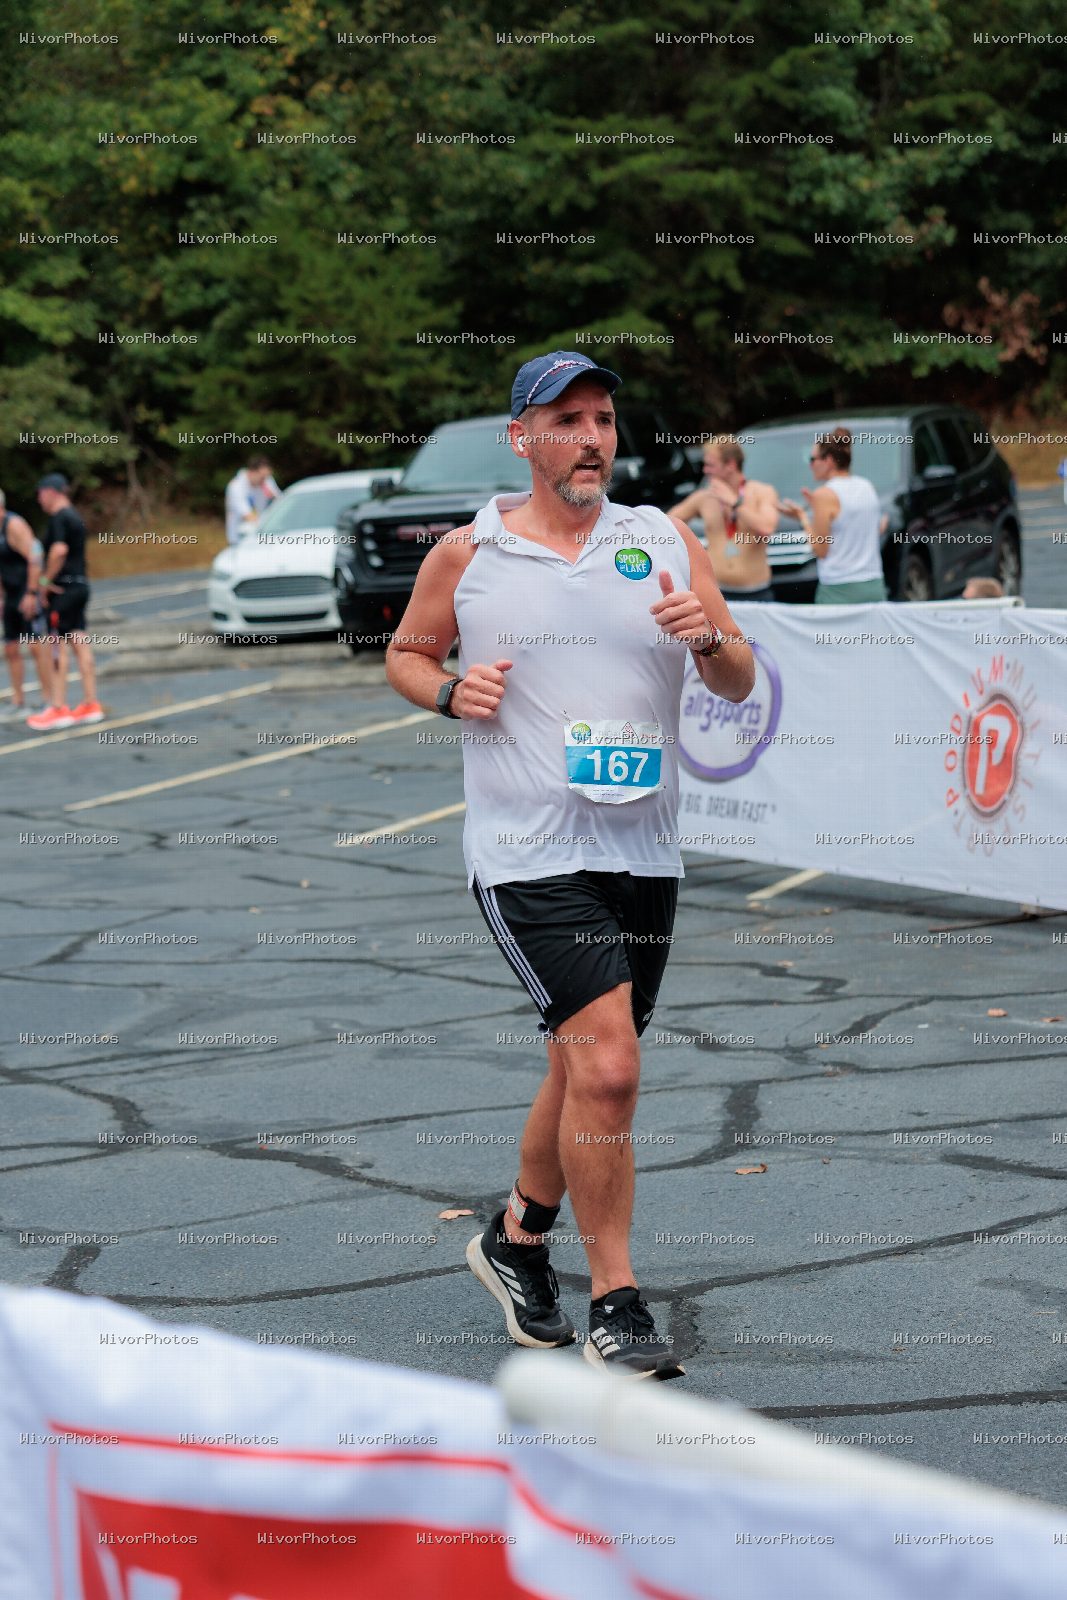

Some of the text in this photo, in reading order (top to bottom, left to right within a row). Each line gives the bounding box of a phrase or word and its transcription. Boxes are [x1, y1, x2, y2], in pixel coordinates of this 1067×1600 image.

[617, 553, 641, 565] SPOT
[626, 563, 648, 573] LAKE
[586, 749, 649, 783] 167
